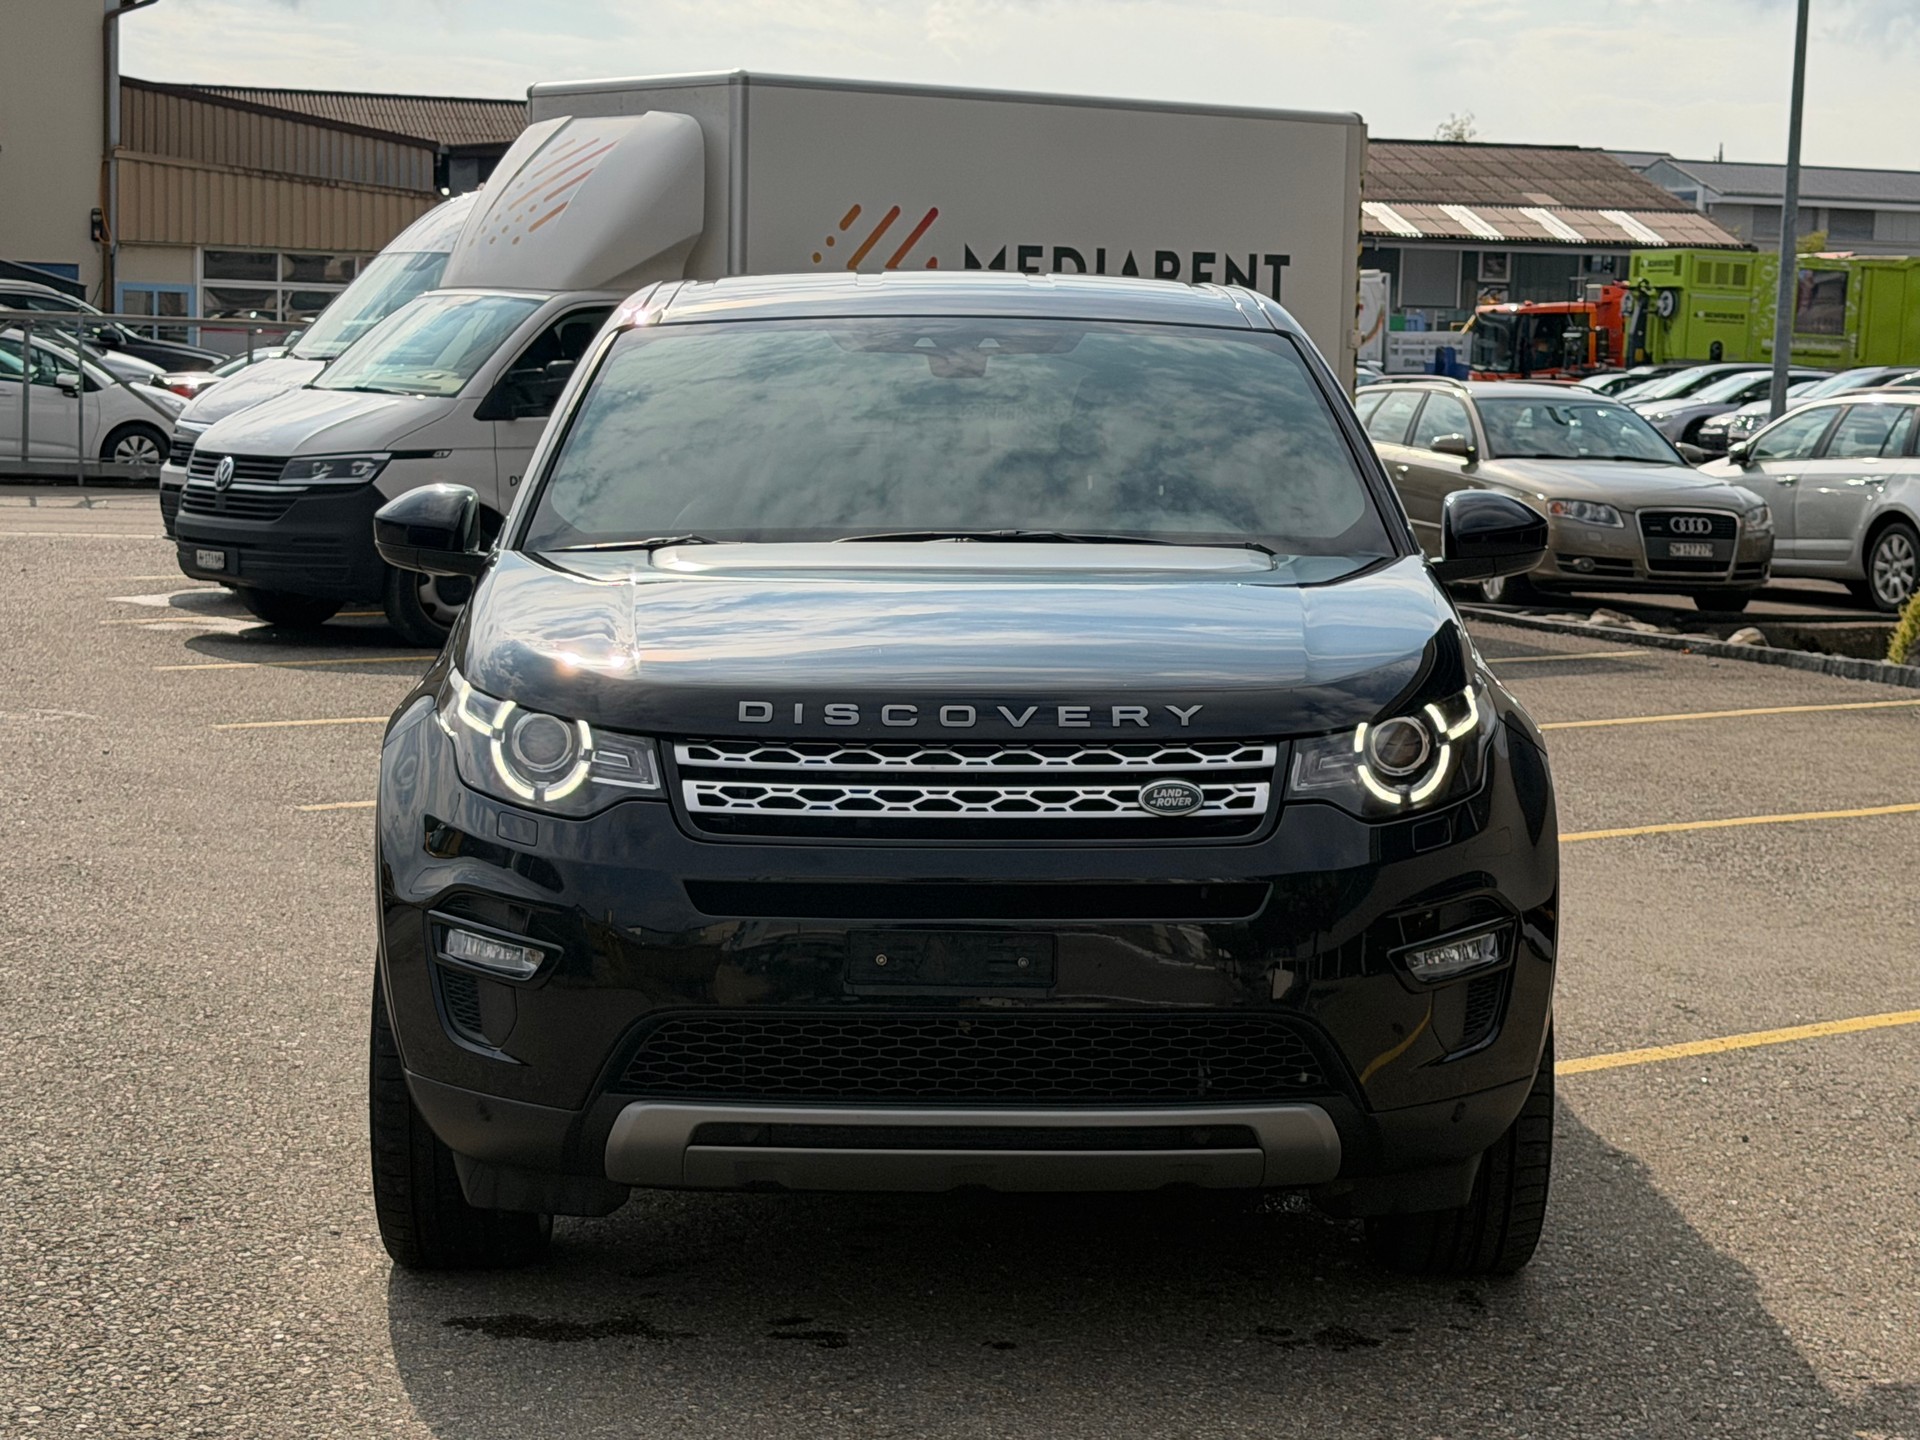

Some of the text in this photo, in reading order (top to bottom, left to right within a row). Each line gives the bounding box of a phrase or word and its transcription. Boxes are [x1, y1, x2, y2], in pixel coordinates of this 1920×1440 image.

[737, 700, 1204, 729] DISCOVERY
[1153, 788, 1183, 798] LAND
[1156, 797, 1192, 807] ROVER
